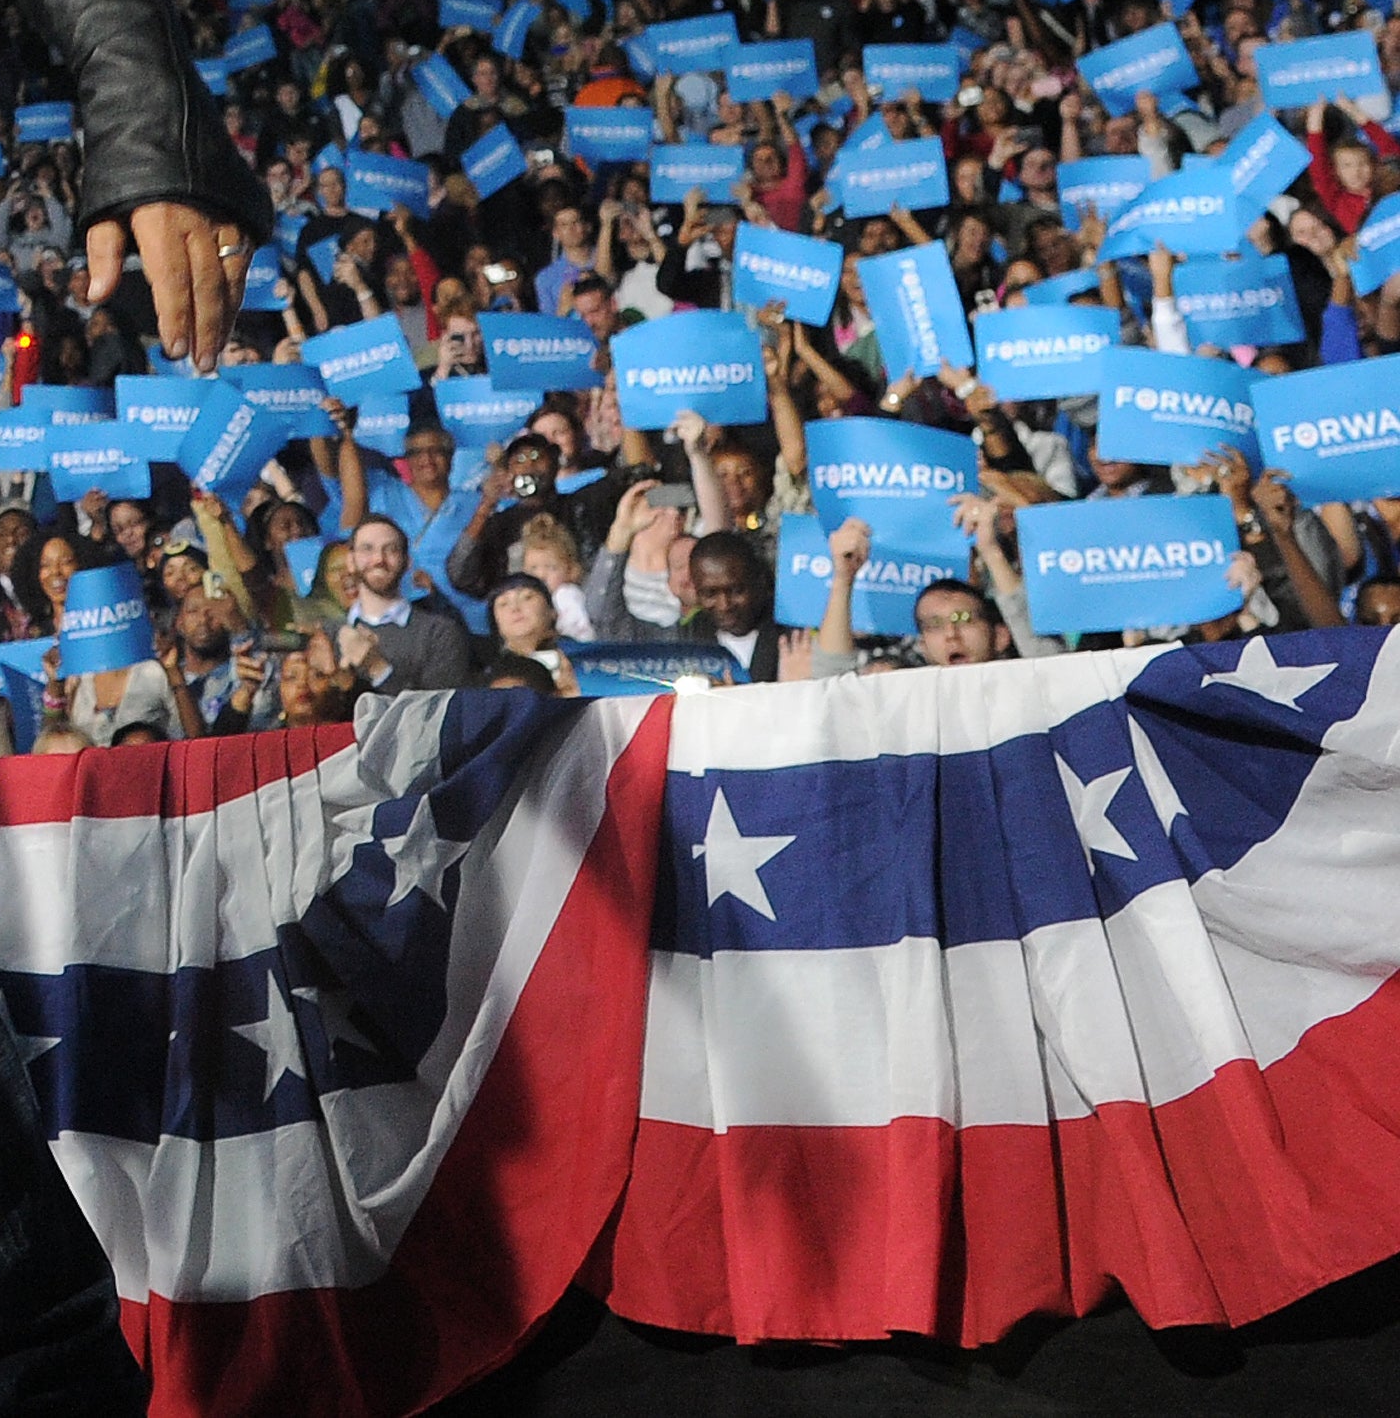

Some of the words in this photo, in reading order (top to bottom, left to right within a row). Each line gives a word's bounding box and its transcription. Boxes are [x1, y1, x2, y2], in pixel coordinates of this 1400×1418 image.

[626, 362, 754, 388] FORWARD!
[1114, 385, 1255, 423] FORWAR
[813, 462, 965, 492] FORWARD!
[790, 553, 955, 583] FOWARD!
[1038, 539, 1225, 576] FORWARD!
